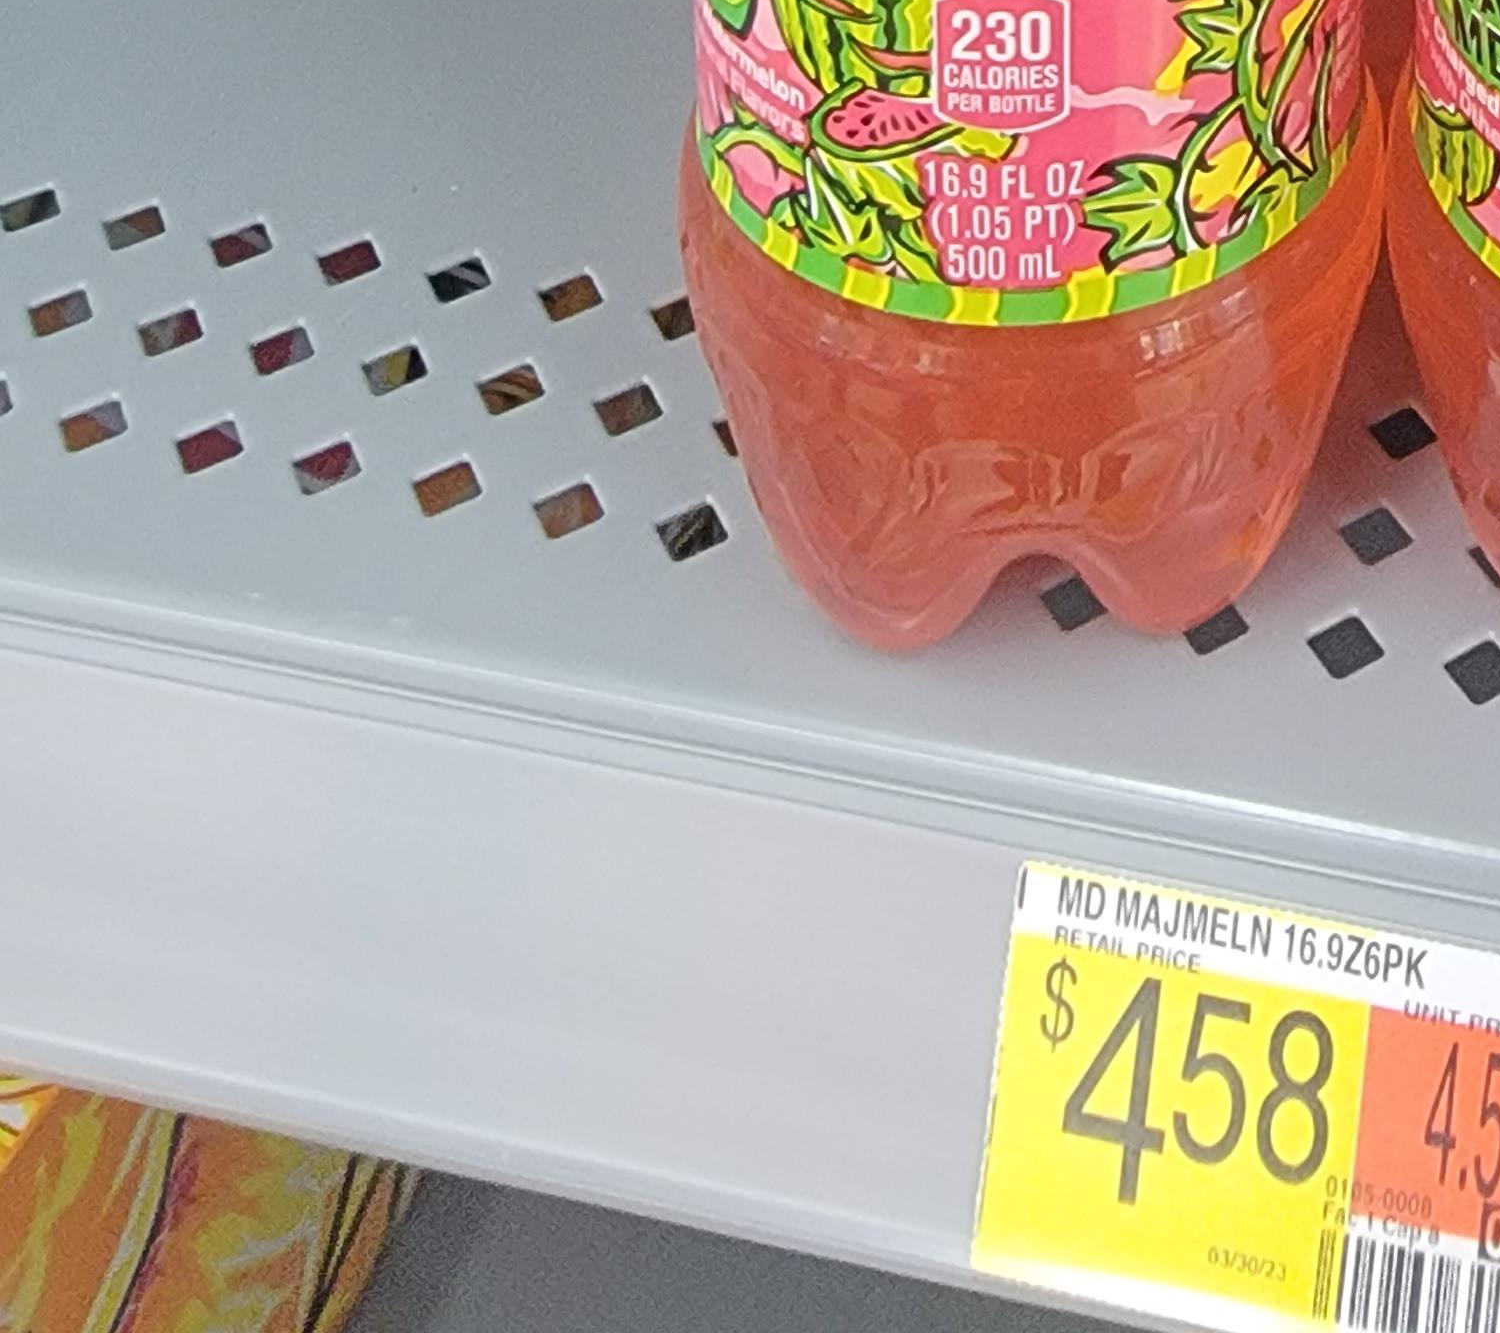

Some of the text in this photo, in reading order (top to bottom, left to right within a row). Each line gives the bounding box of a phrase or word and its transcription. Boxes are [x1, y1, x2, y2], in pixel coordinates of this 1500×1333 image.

[951, 9, 1052, 62] 230
[943, 63, 1060, 90] CALORIES
[946, 92, 1057, 115] PER BOTTLE
[923, 160, 1086, 200] 16.9 FL OZ
[930, 201, 1077, 245] (1.05 PT)
[946, 244, 1062, 280] 500 mL
[1053, 924, 1202, 975] RETAIL PRICE
[1056, 875, 1107, 921] MD
[1114, 886, 1272, 958] MAJMELN
[1284, 923, 1429, 991] 16.9Z6PK
[1403, 999, 1462, 1026] UNIT
